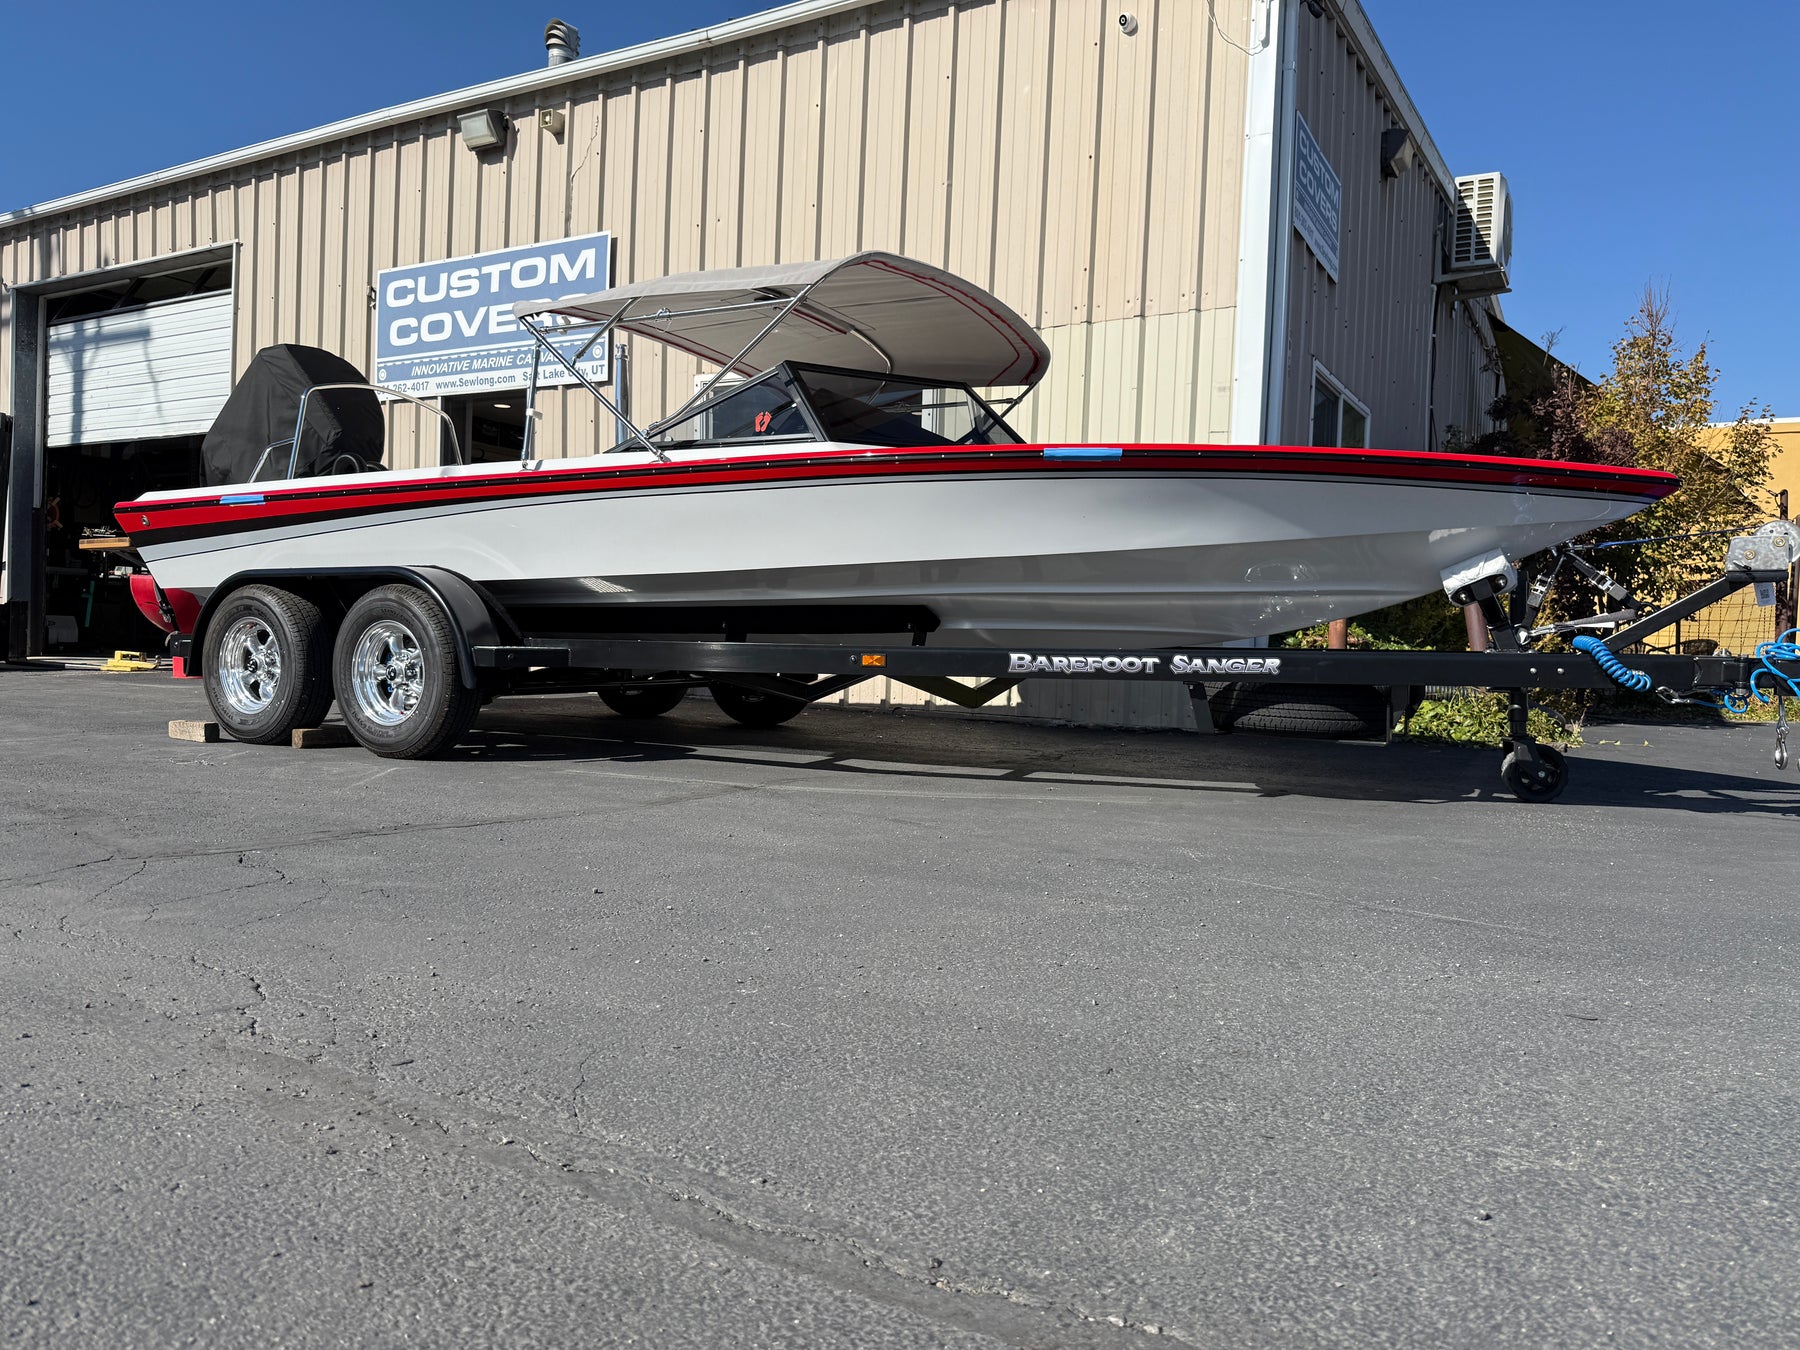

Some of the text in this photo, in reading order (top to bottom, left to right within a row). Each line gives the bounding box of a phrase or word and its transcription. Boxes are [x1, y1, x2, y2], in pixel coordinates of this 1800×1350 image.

[1300, 129, 1339, 208] CUSTOM
[1300, 160, 1337, 232] COVERS
[386, 248, 596, 308] CUSTOM
[411, 360, 470, 376] INNOVATIVE
[472, 355, 514, 370] MARINE
[435, 374, 516, 390] www.Sewlong.com
[523, 370, 540, 382] Sat
[543, 369, 565, 380] Lake
[592, 364, 605, 375] UT
[1008, 652, 1282, 676] BAREFOOT SANGER
